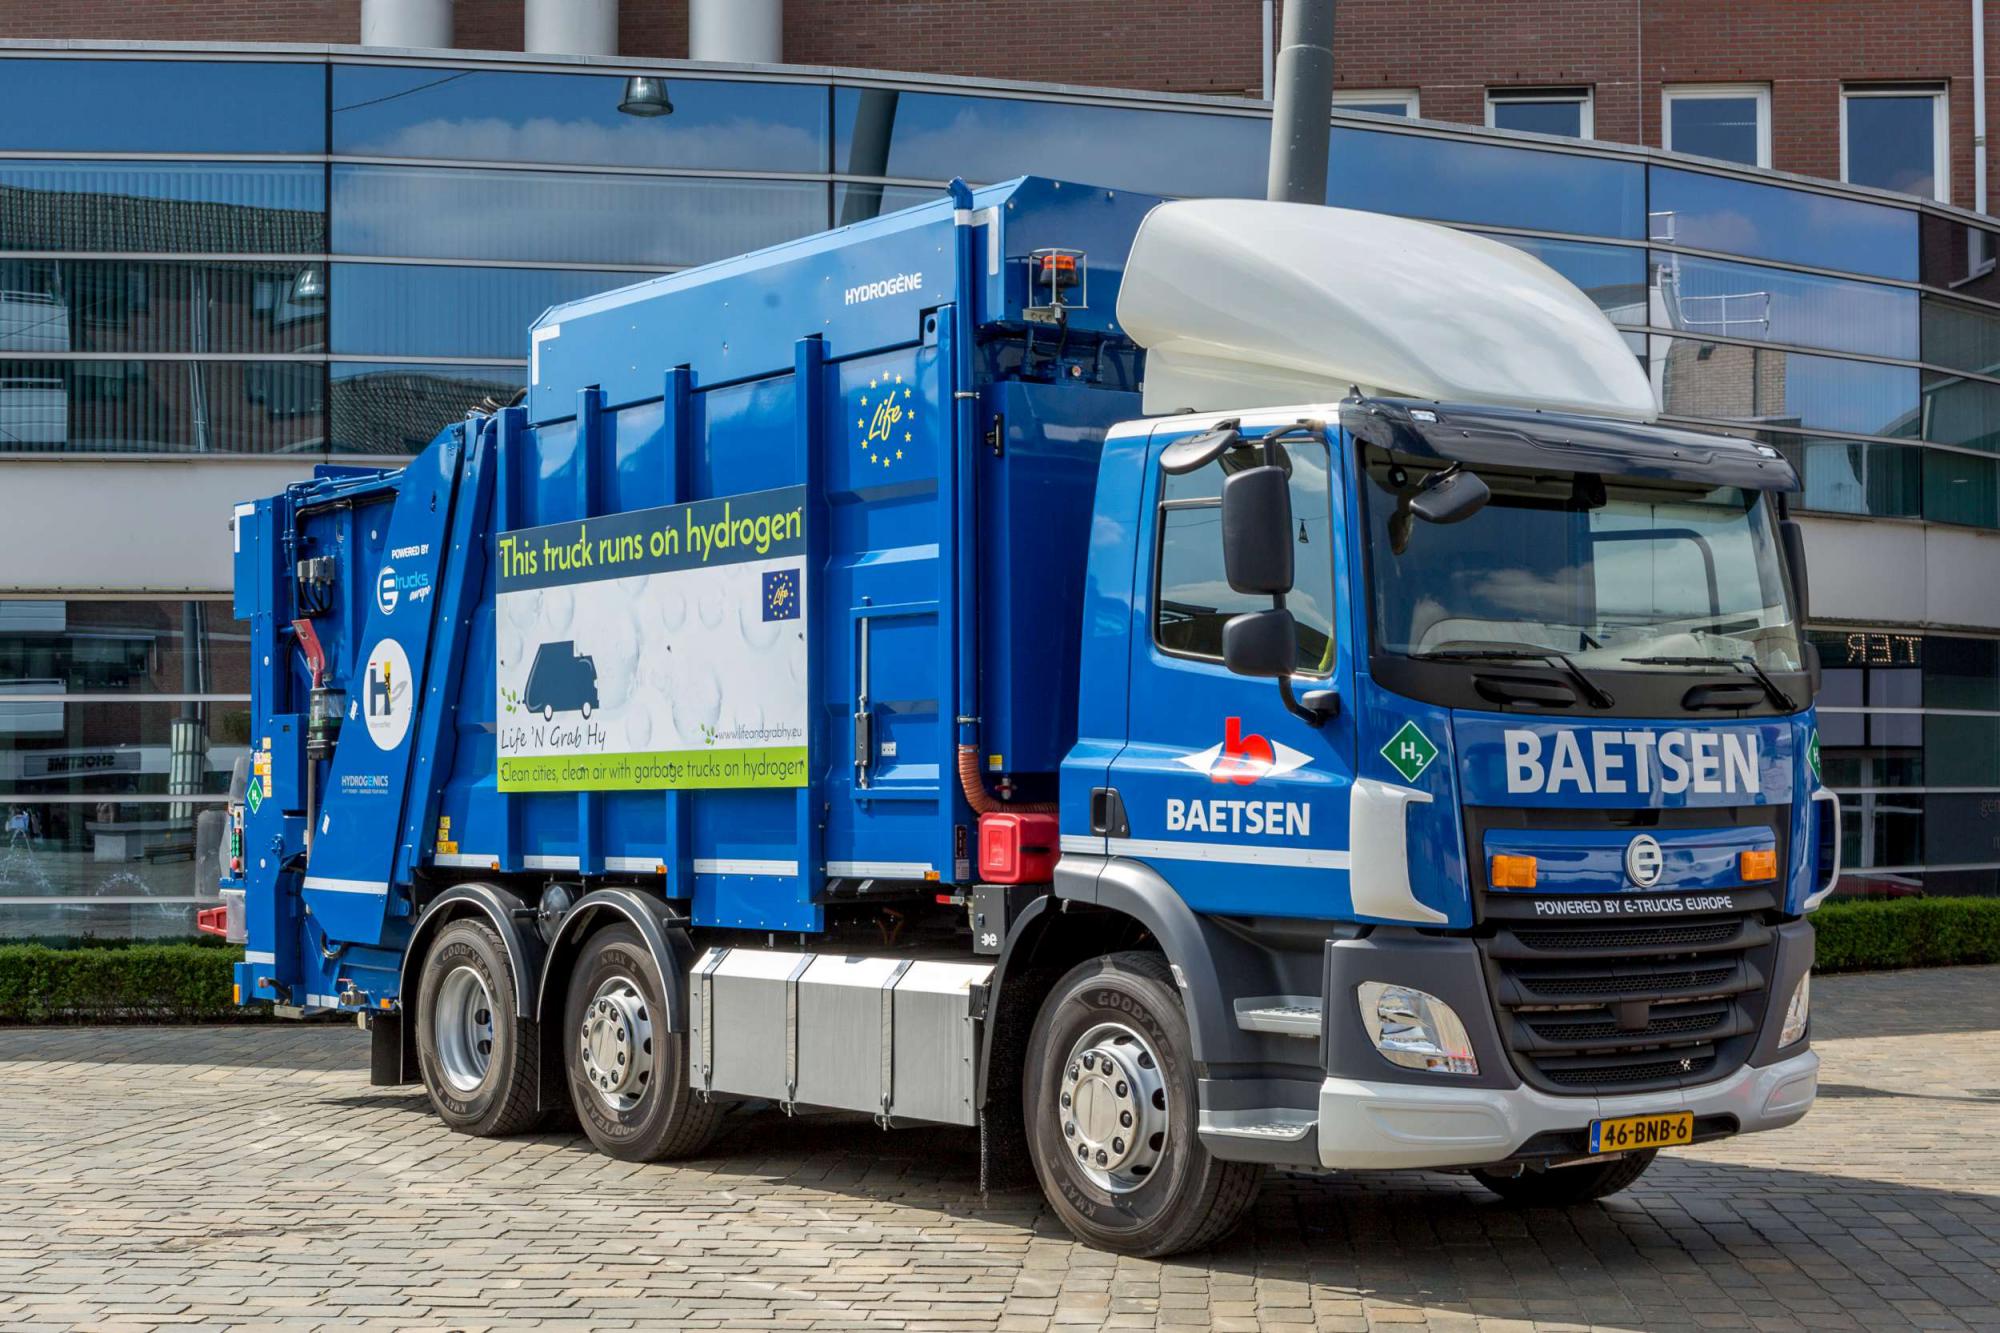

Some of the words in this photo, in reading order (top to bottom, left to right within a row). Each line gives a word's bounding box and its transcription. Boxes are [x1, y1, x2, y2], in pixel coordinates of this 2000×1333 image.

[845, 272, 922, 305] HYDROGÈNE
[868, 391, 903, 441] Life
[391, 545, 420, 560] POWERED
[420, 543, 430, 555] BY
[500, 536, 538, 577] This
[544, 524, 593, 573] truck
[599, 535, 643, 565] runs
[650, 527, 679, 557] on
[686, 502, 801, 562] hydrogen
[501, 727, 527, 754] Life
[550, 725, 582, 748] Grab
[587, 722, 606, 751] Hy
[501, 761, 529, 781] Clean
[562, 760, 589, 780] clean
[592, 763, 607, 780] air
[609, 757, 631, 779] with
[634, 756, 684, 783] garbage
[686, 754, 720, 777] trucks
[724, 763, 740, 777] on
[743, 752, 803, 781] hydrogen
[1504, 729, 1760, 794] BAETSEN
[341, 775, 389, 787] HYDROGENICS
[1166, 798, 1311, 836] BAETSEN
[1535, 900, 1601, 915] POWERED
[1605, 900, 1621, 914] BY
[1624, 898, 1684, 913] E-TRUCKS
[1686, 896, 1733, 911] EUROPE
[1604, 1118, 1687, 1146] 46-BNB-6
[1059, 1178, 1096, 1217] KMAX
